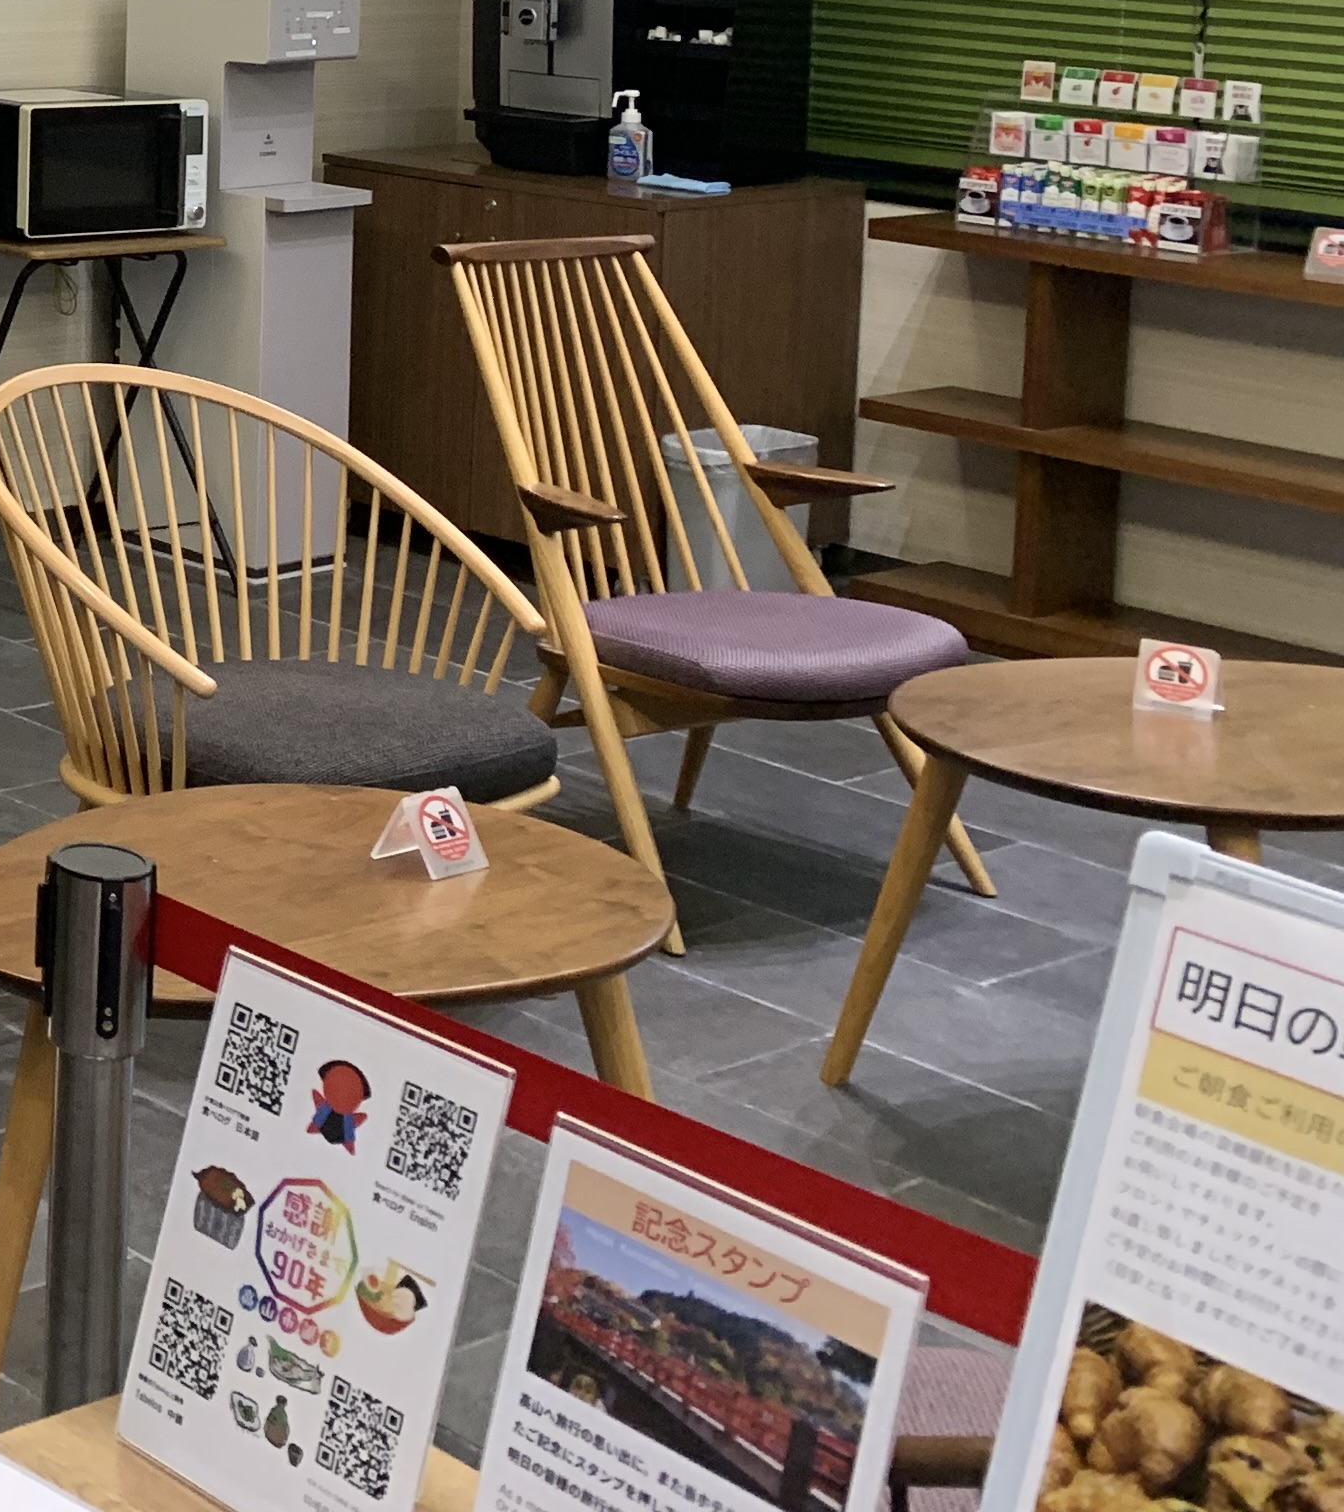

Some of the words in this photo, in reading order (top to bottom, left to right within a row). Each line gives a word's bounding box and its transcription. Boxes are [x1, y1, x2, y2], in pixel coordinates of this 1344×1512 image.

[1177, 960, 1344, 1059] 明日の
[283, 1190, 342, 1245] 感謝
[410, 1211, 438, 1232] English
[271, 1250, 326, 1301] 90年
[631, 1201, 811, 1303] 記念スタンプ
